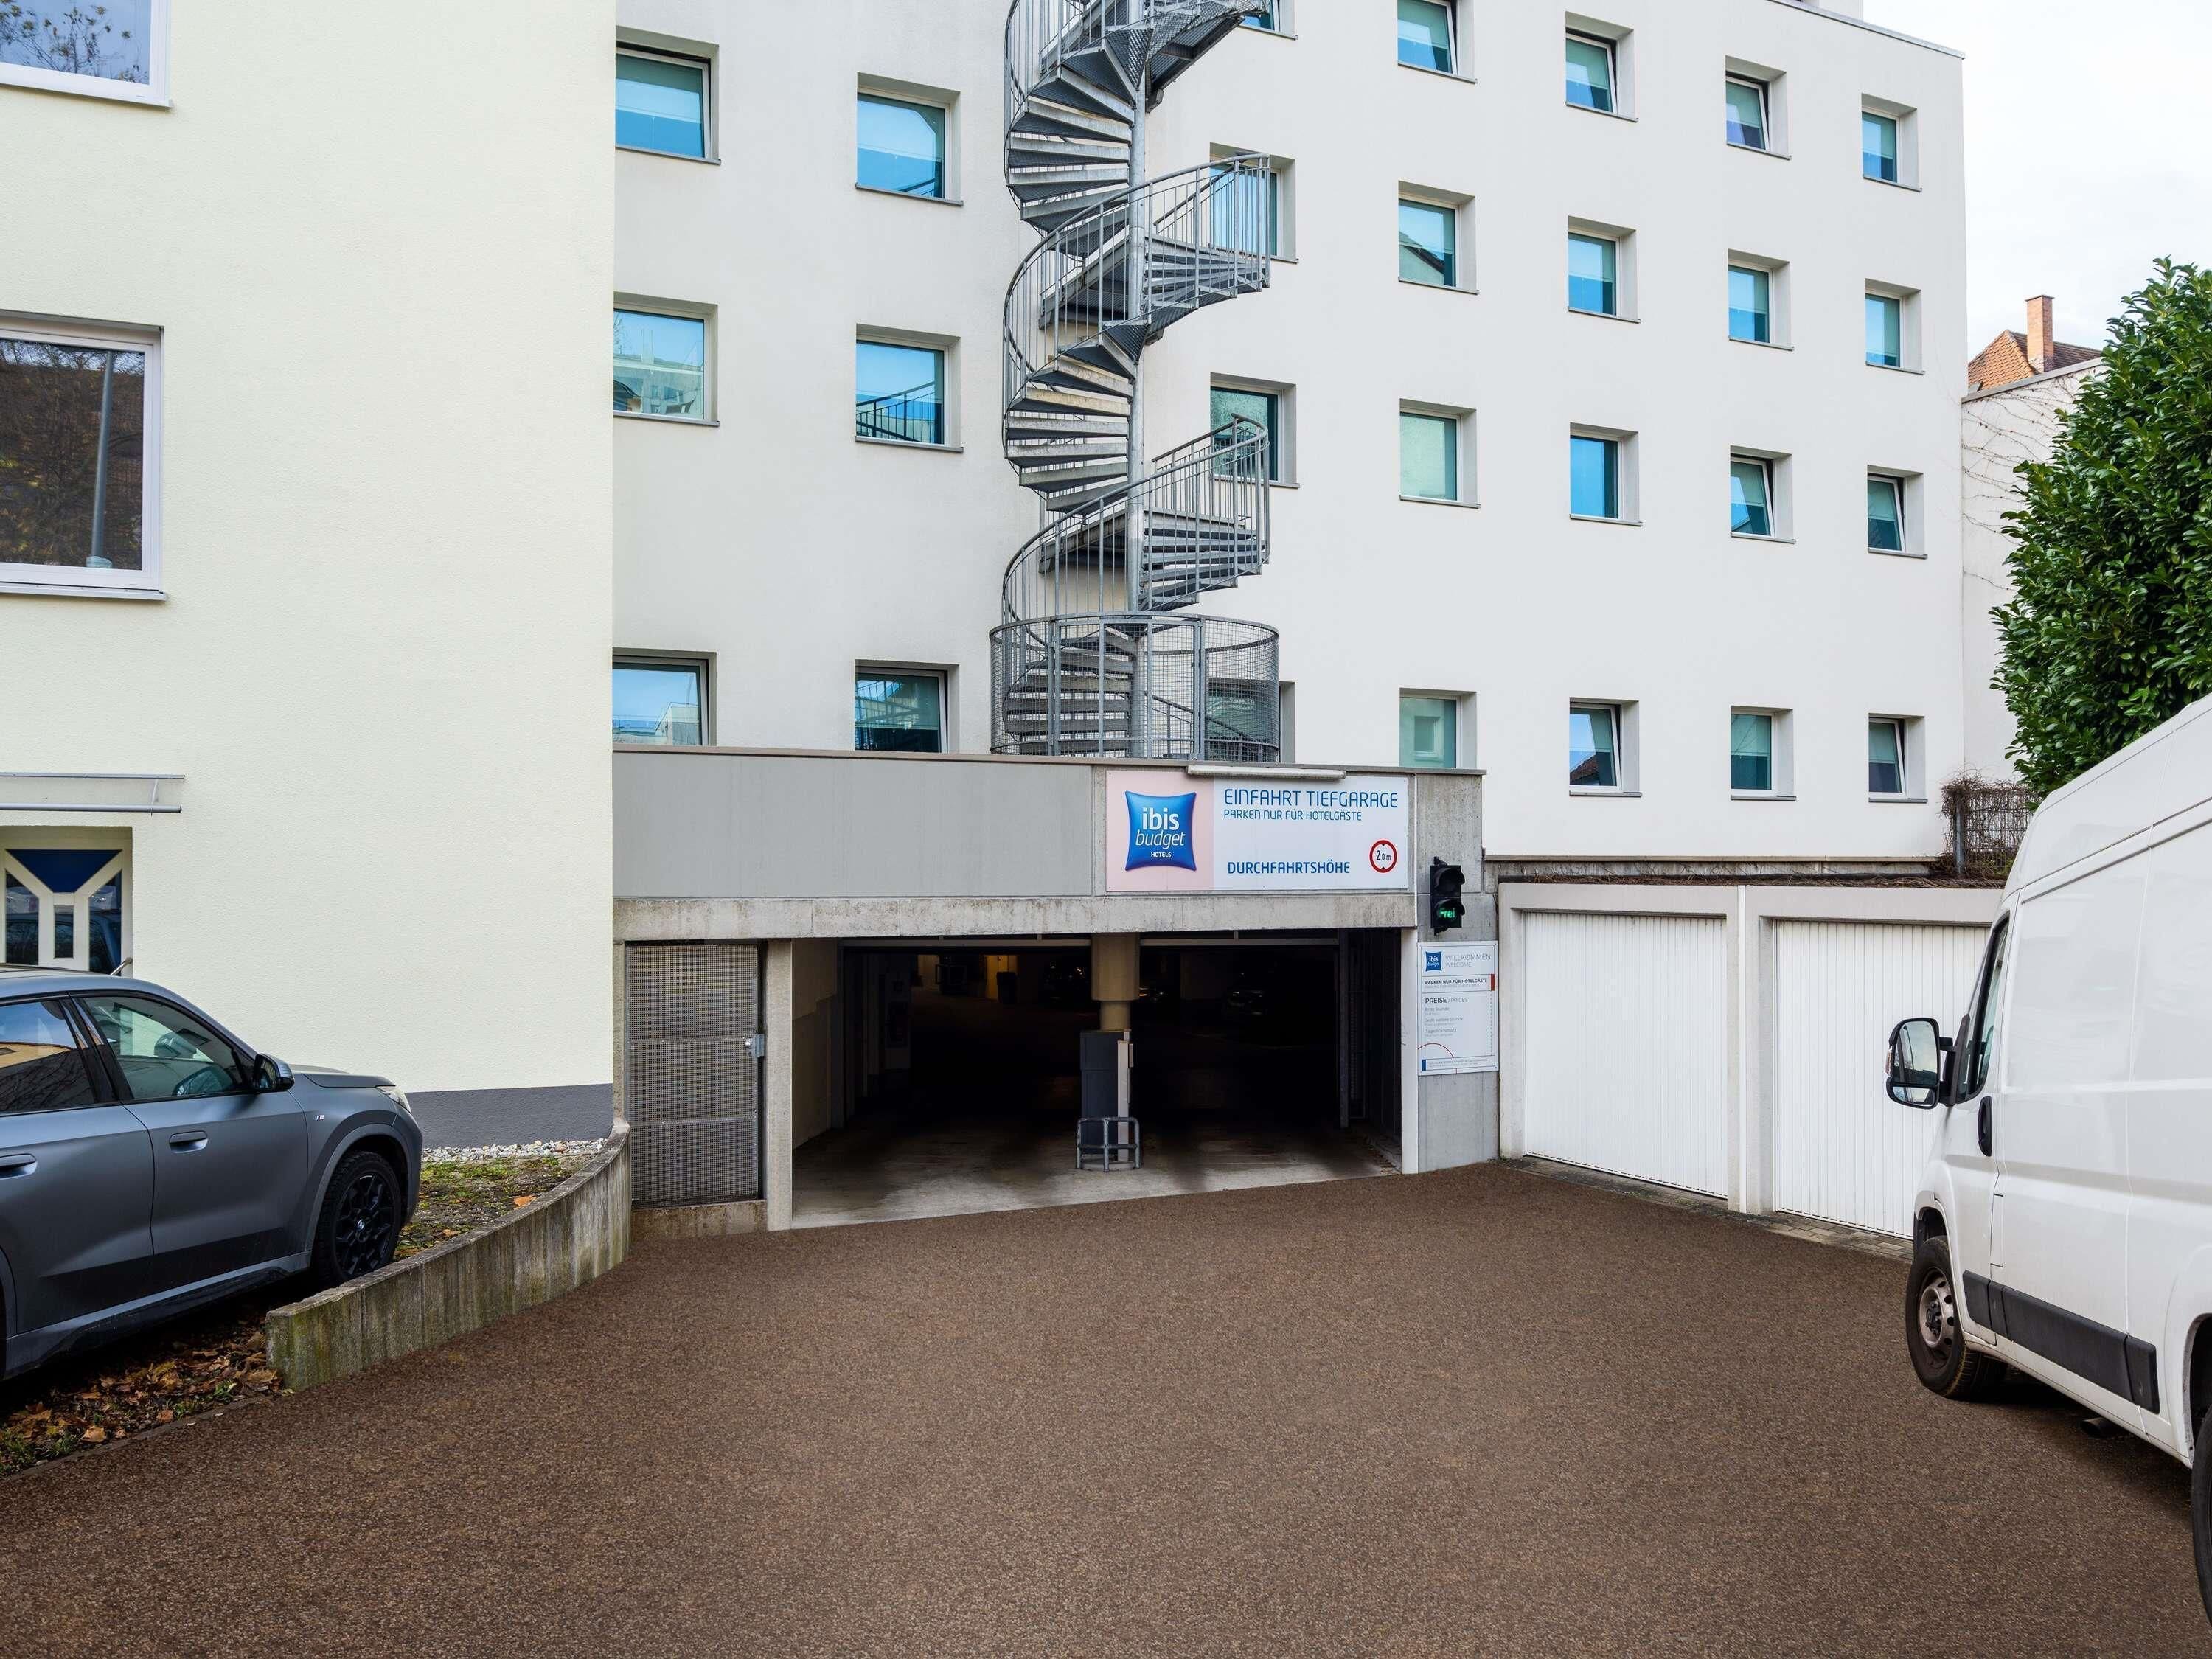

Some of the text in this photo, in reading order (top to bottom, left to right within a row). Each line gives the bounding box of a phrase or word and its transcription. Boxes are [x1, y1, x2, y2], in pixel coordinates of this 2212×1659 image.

[1225, 788, 1398, 808] EINFAHRT TIEFGARAGE
[1142, 807, 1180, 830] ibis
[1224, 808, 1362, 821] PARKEN NUR FÜR HOTELGÄSTE
[1135, 830, 1186, 849] budget
[1227, 859, 1351, 874] DURCHFAHRTSHÖHE
[1445, 953, 1492, 961] WILLKOMMEN
